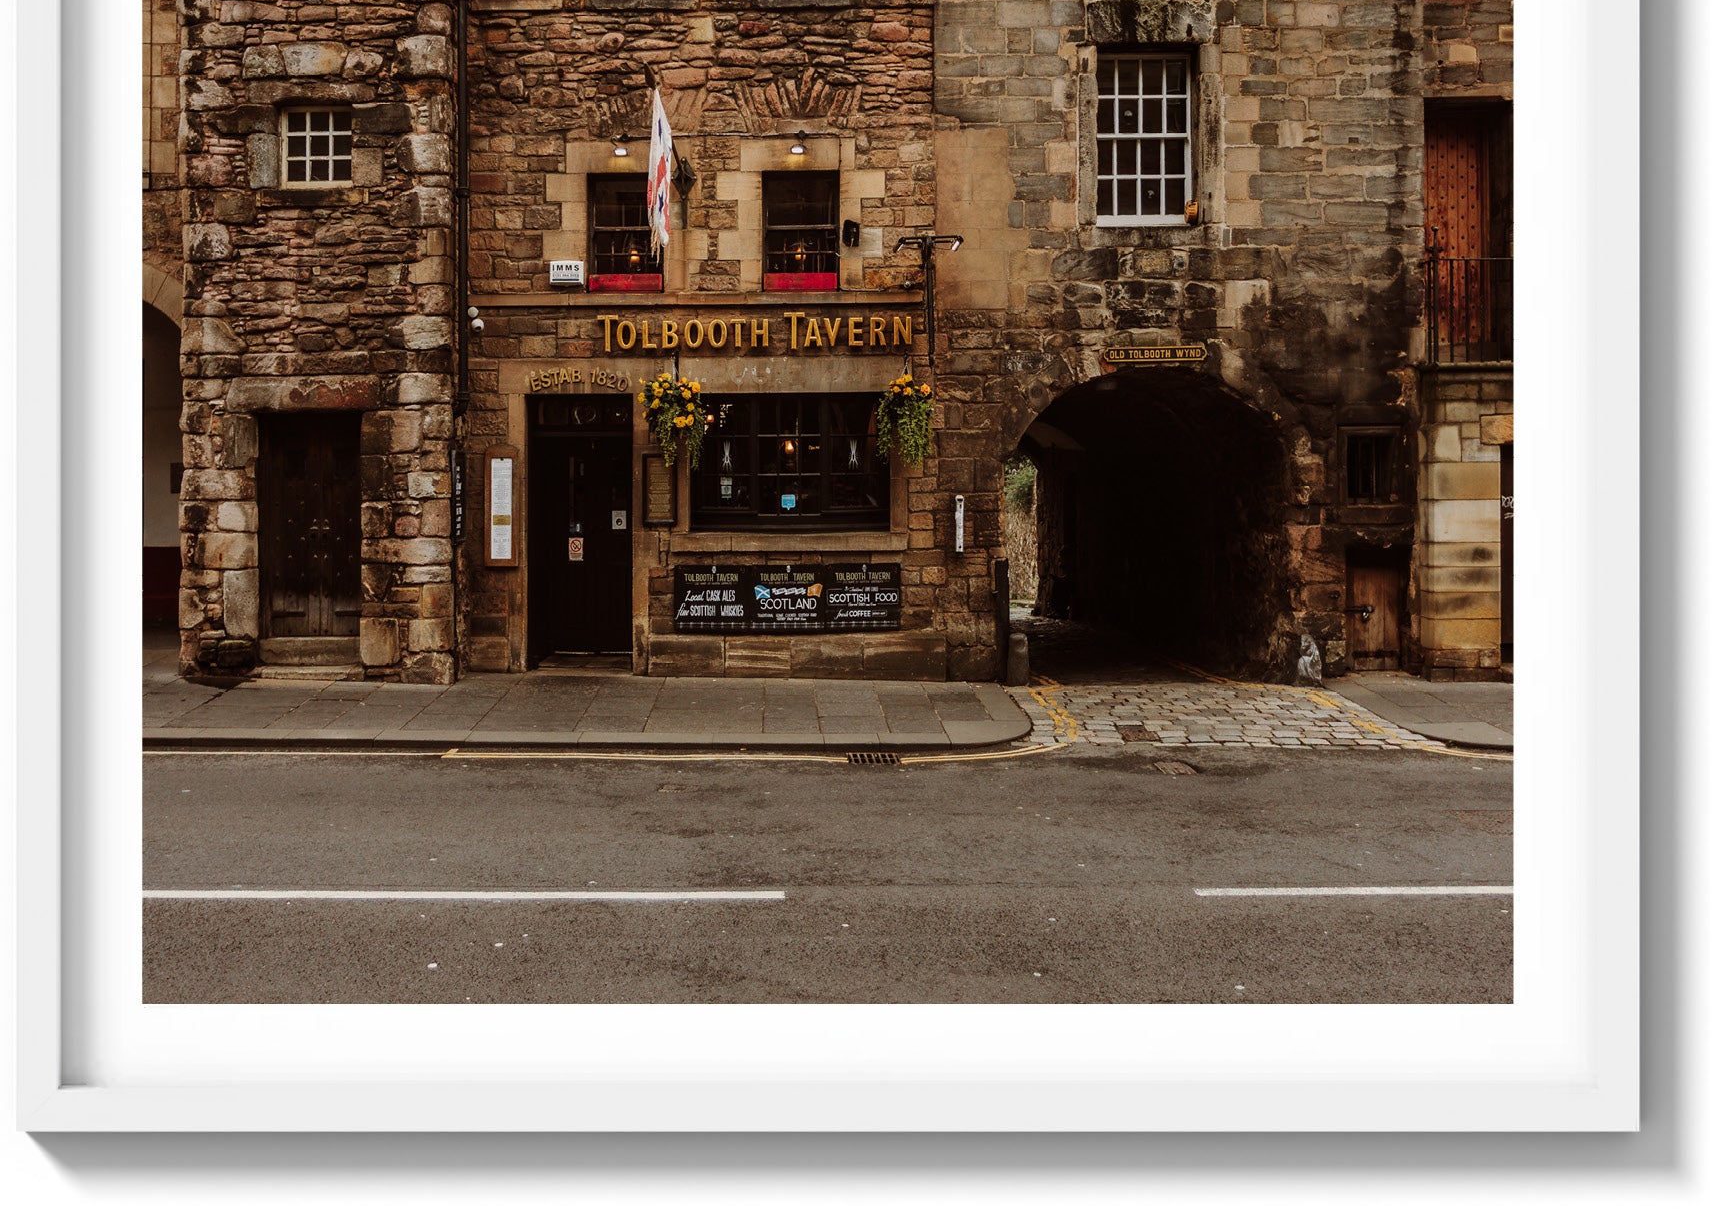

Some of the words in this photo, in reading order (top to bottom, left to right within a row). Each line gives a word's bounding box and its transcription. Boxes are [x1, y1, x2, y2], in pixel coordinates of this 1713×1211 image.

[552, 264, 580, 272] IMMS
[597, 314, 769, 353] TOLBOOTH
[783, 311, 912, 350] TAVERN
[1109, 350, 1125, 359] OLD
[1128, 350, 1171, 359] TOLBOOTH
[1175, 348, 1201, 358] WYND
[530, 368, 585, 391] ESTAB.
[590, 368, 629, 391] 1820
[684, 573, 714, 582] TOLBOOTH
[716, 573, 739, 582] TAVERN
[760, 573, 788, 582] TOLBOOTH
[793, 573, 815, 581] TAVERN
[835, 572, 866, 581] TOLBOOTH
[868, 571, 891, 580] TAVERN
[685, 590, 705, 601] Local
[706, 589, 721, 601] CASK
[722, 589, 736, 601] ALES
[829, 593, 870, 603] SCOTTISH
[875, 592, 898, 602] FOOD
[760, 598, 817, 610] SCOTLAND
[690, 605, 716, 616] SCOTTISH
